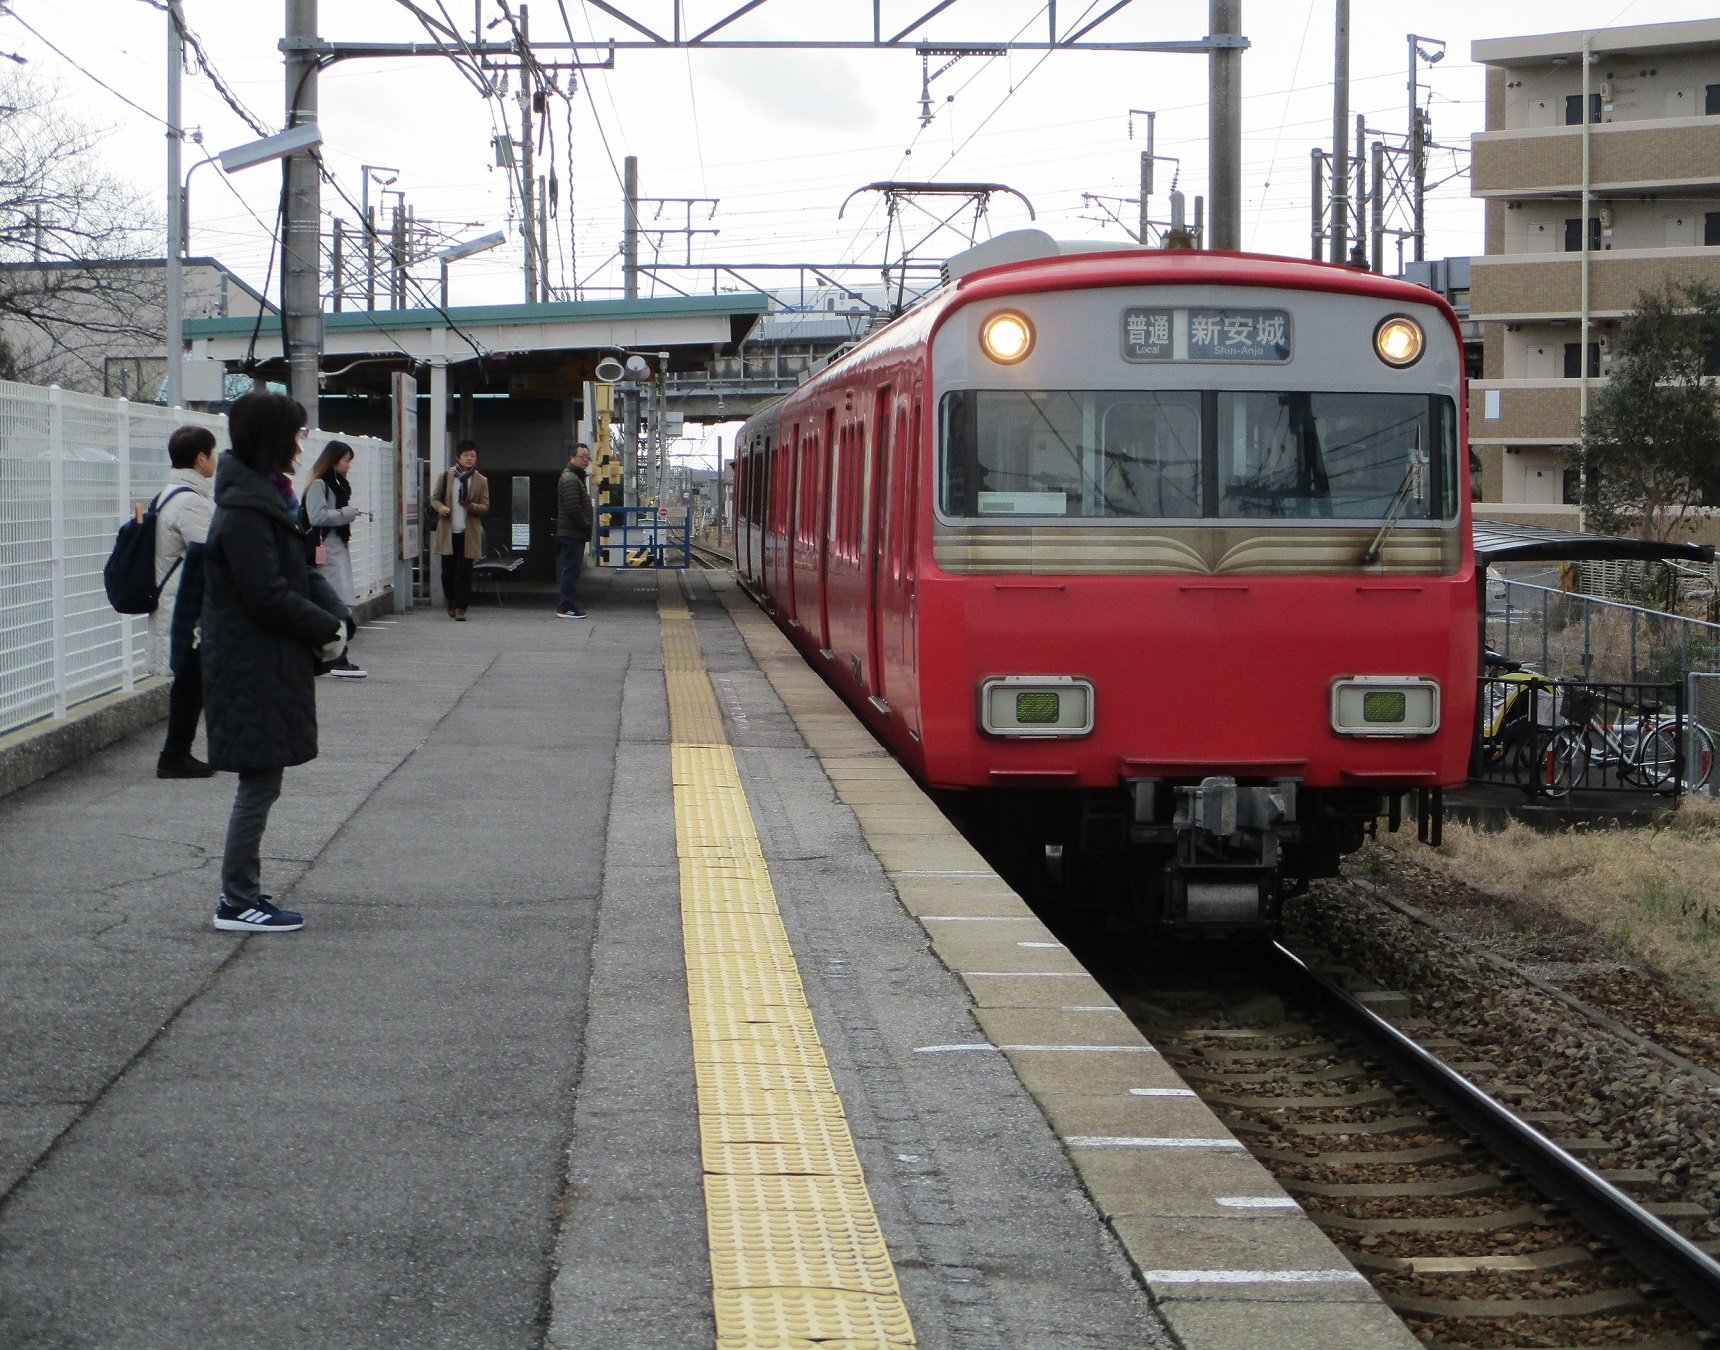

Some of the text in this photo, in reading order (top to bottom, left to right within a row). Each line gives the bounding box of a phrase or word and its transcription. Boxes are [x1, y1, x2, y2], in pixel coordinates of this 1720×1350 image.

[1127, 314, 1169, 345] 普通
[1191, 315, 1286, 346] 新安城
[1136, 345, 1160, 354] Local
[1214, 345, 1264, 356] Shin-Anjo
